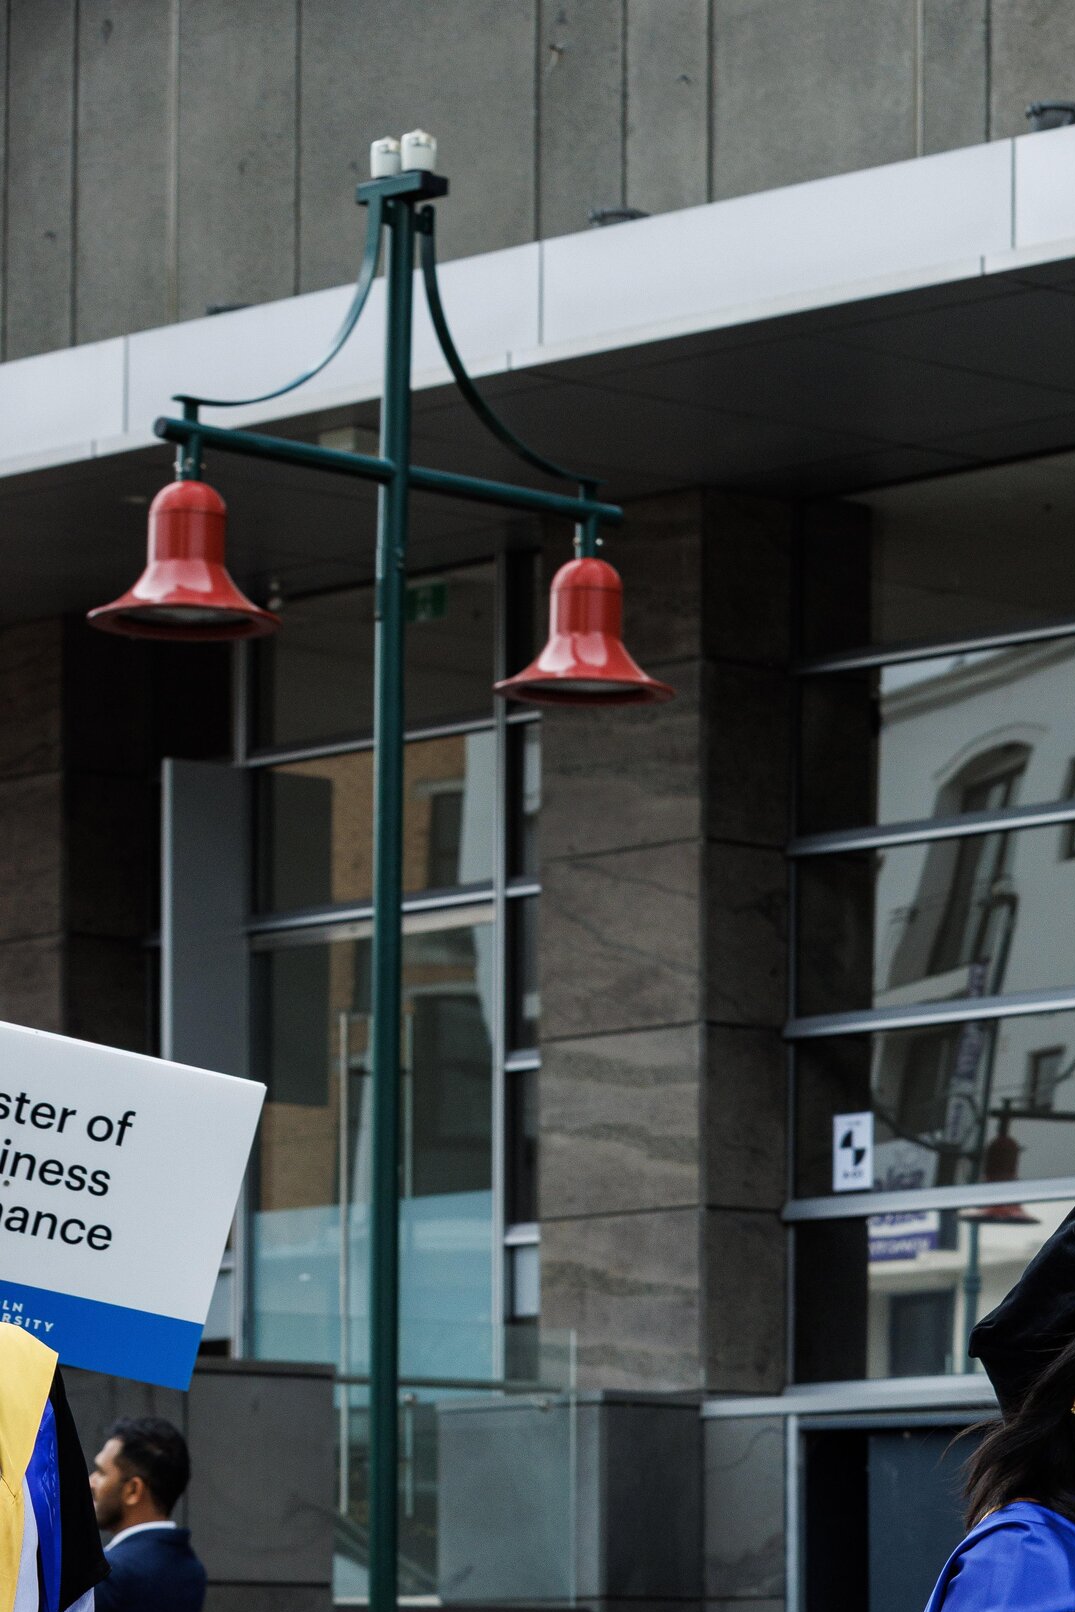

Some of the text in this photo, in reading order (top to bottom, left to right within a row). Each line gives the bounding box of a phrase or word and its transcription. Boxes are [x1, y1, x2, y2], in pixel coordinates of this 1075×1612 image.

[86, 1110, 136, 1146] of
[0, 1138, 110, 1196] iness
[0, 1202, 112, 1251] ance
